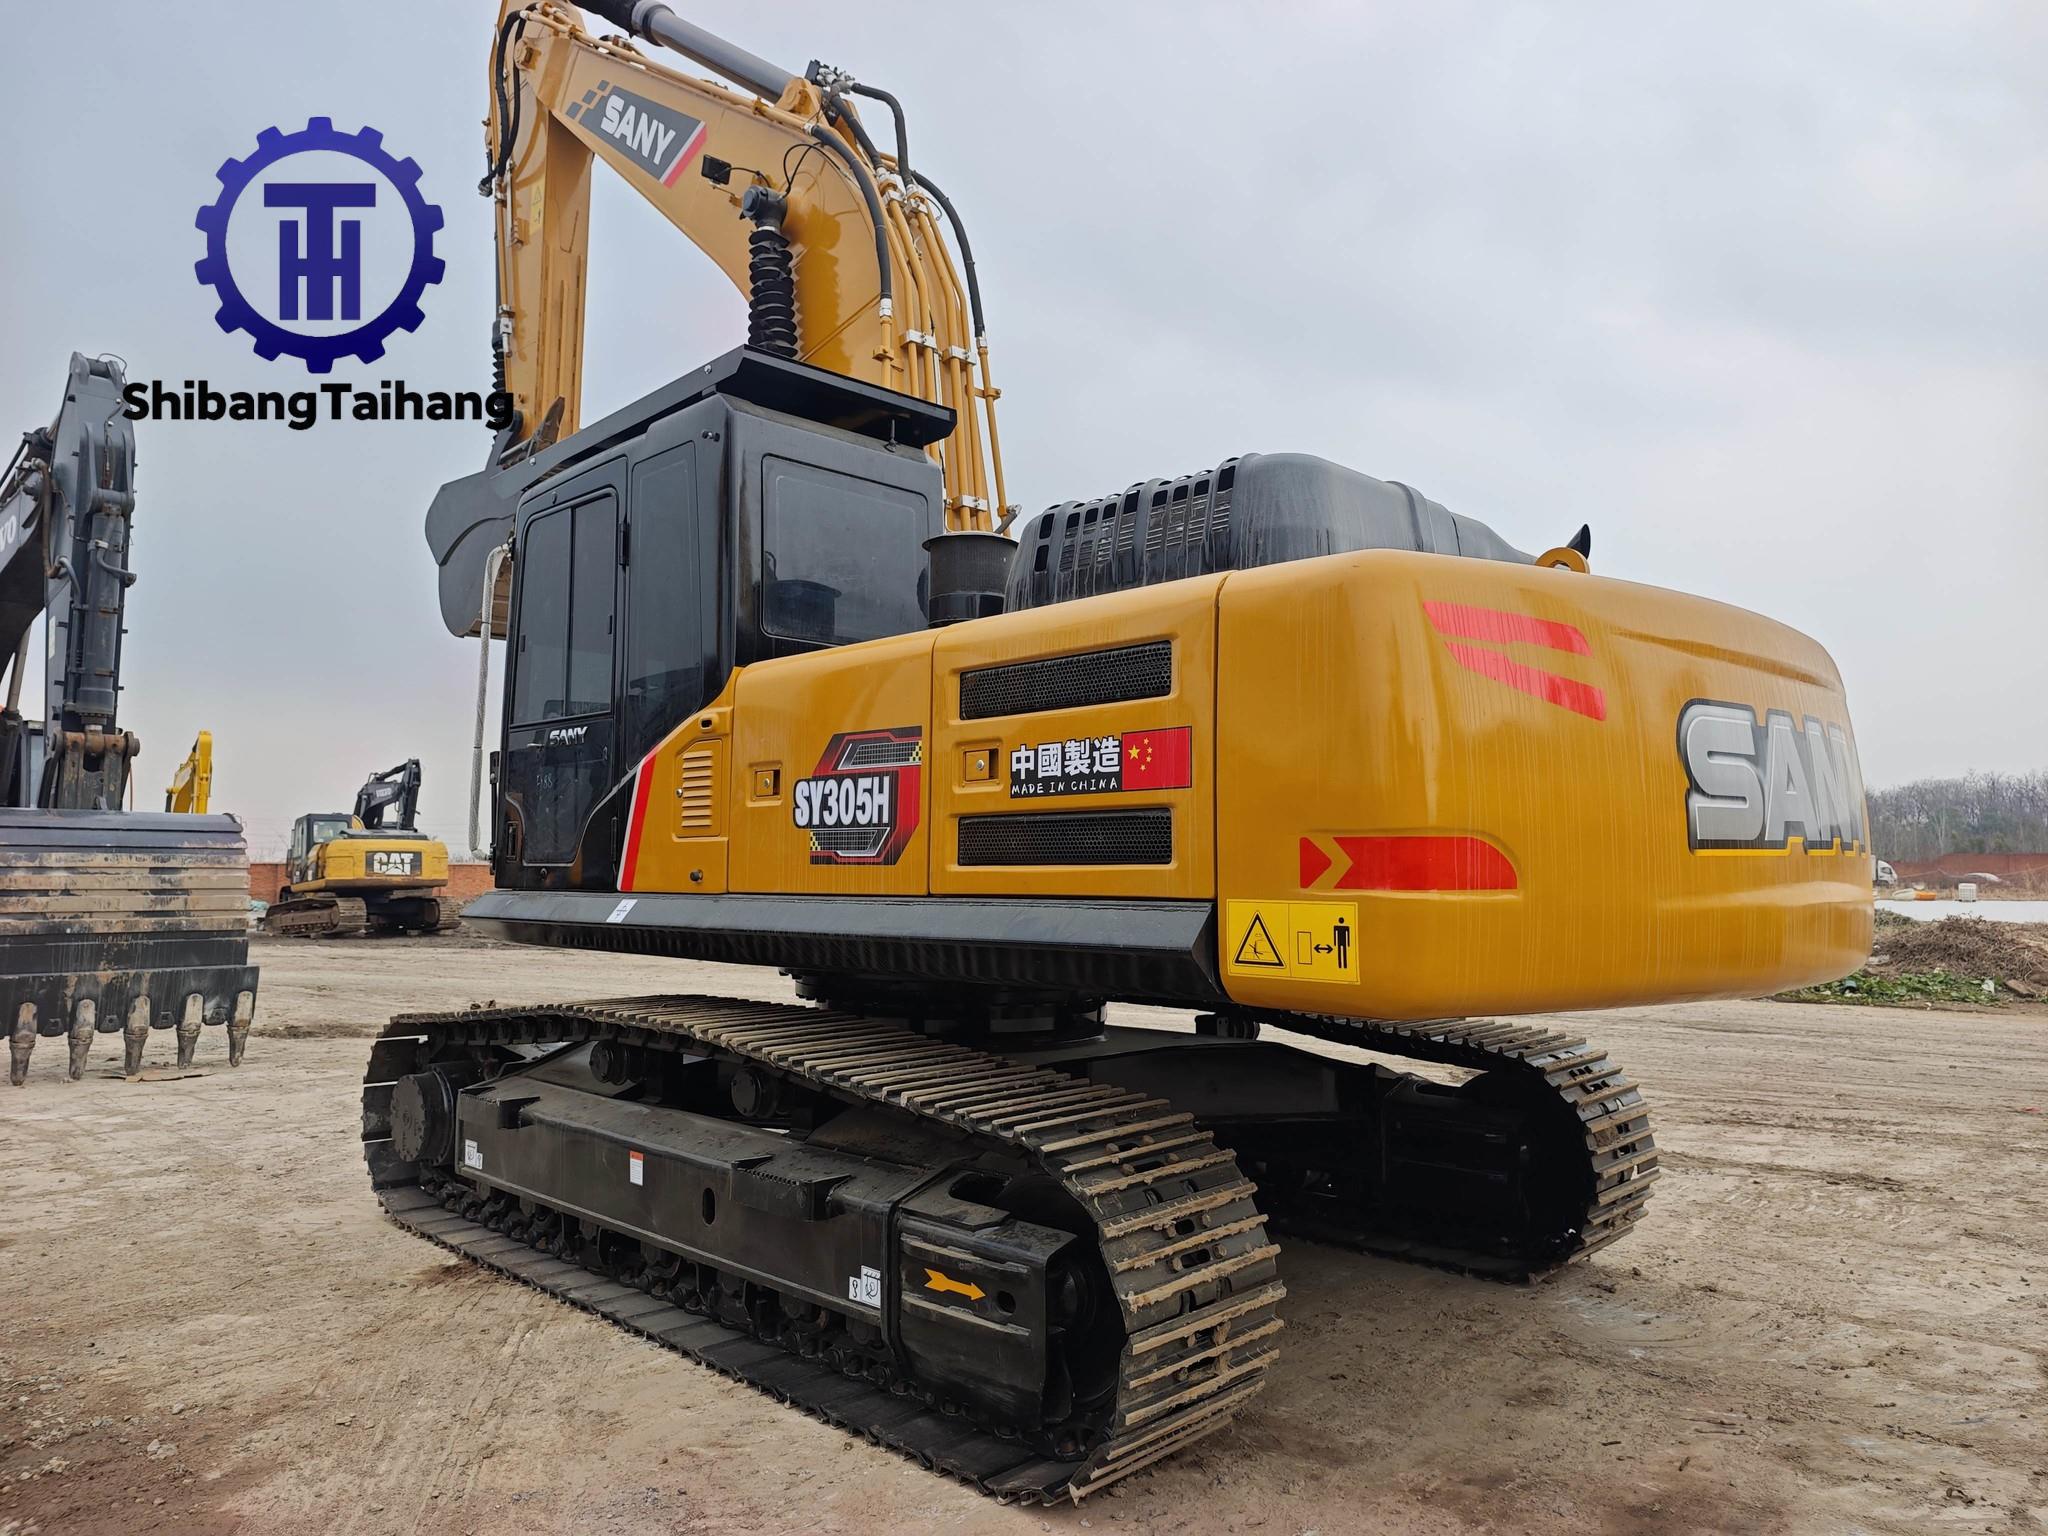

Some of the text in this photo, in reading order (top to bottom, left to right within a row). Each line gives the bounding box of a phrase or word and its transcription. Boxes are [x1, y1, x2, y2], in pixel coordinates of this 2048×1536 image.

[600, 94, 676, 166] SANY
[549, 726, 588, 745] SANY
[1011, 735, 1121, 780] 中國製造
[1011, 777, 1118, 795] MADE IN CHINA
[1678, 699, 1869, 852] SAN
[794, 775, 890, 827] SY305H
[373, 852, 414, 876] CAT
